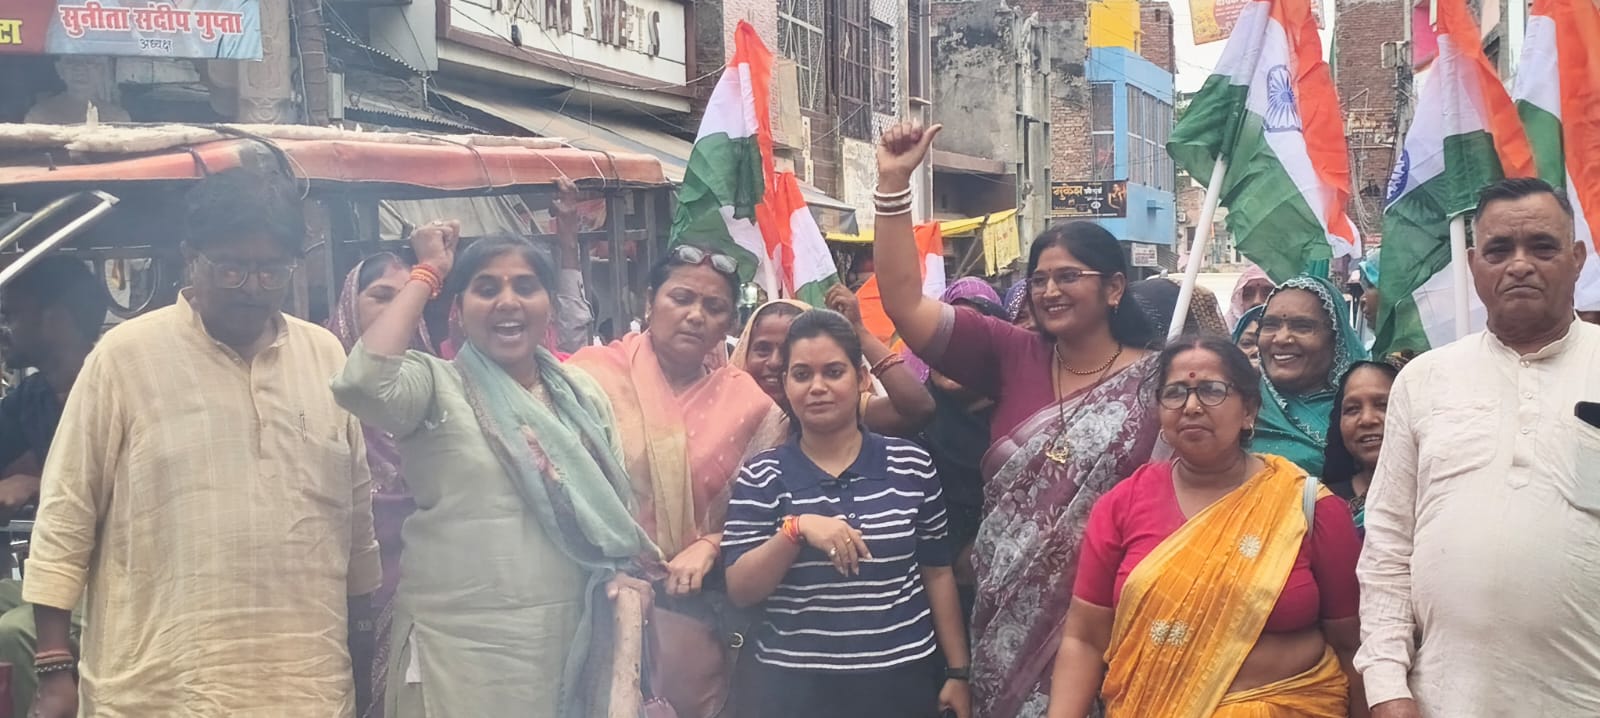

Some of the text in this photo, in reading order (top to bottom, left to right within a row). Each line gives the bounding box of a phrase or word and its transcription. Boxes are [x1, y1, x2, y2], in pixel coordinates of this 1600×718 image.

[59, 2, 243, 41] सुनीता संदीप गुप्ता
[584, 0, 660, 57] SWEETS
[139, 38, 173, 52] अध्यक्ष
